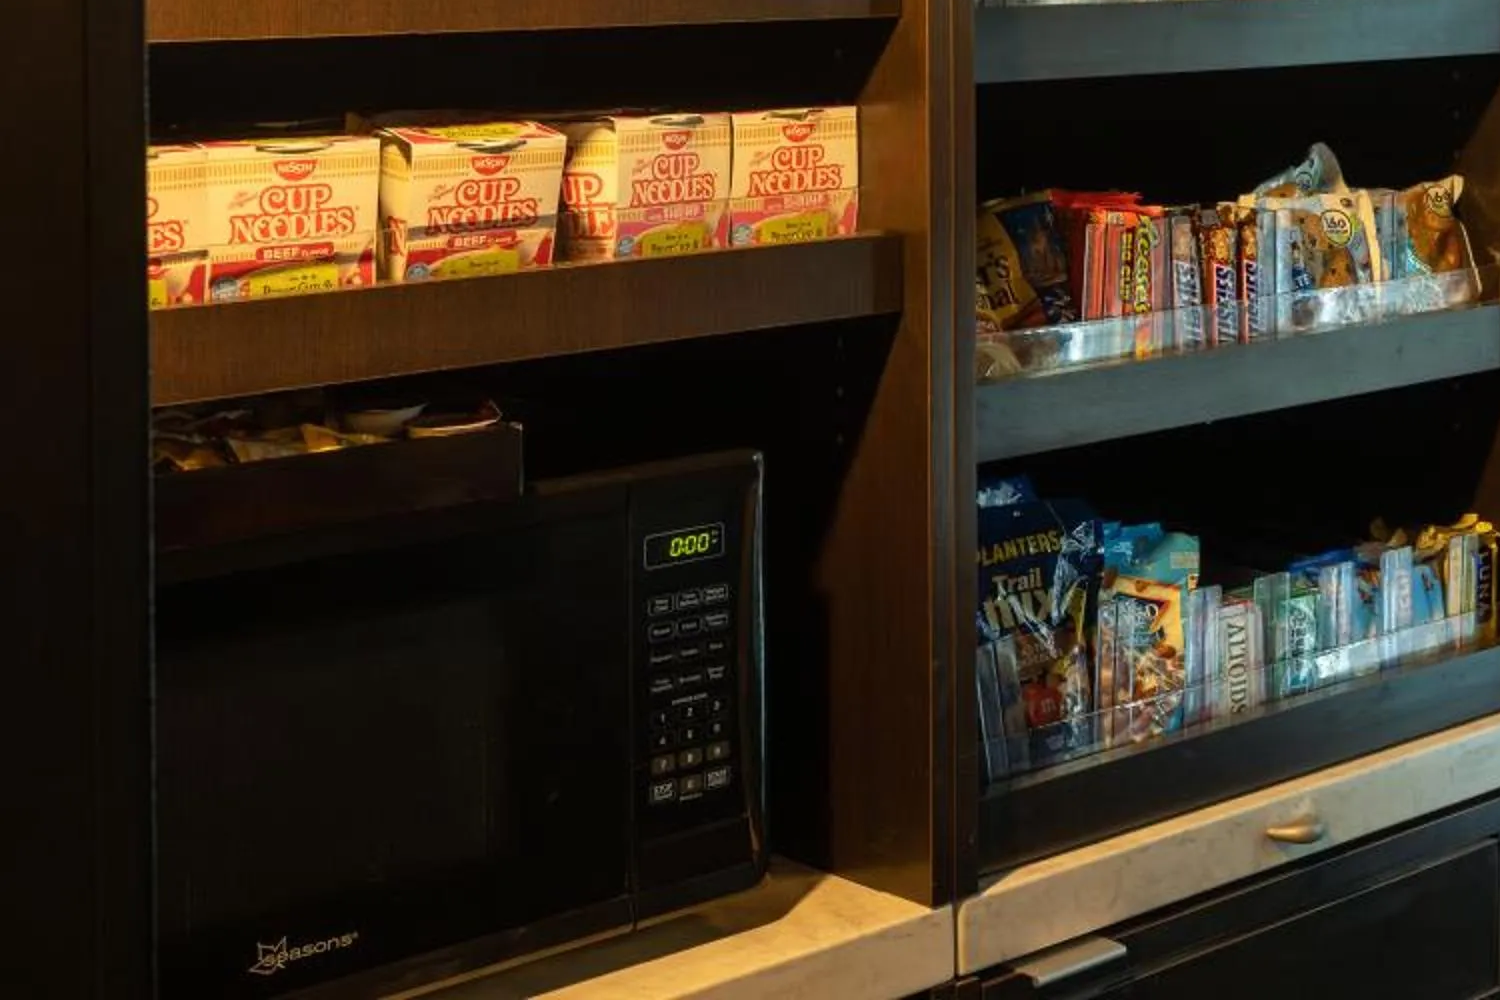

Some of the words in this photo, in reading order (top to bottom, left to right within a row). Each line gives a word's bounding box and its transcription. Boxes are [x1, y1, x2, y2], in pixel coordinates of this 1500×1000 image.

[653, 153, 699, 180] CUP
[772, 145, 824, 171] CUP
[455, 177, 521, 207] CUP
[631, 172, 716, 208] NOODLES
[748, 164, 842, 198] NOODLES
[259, 183, 333, 217] CUP
[427, 197, 539, 236] NOODLES
[229, 205, 356, 245] NOODLES
[669, 533, 711, 557] 0:00
[978, 530, 1060, 567] LANTERS
[1227, 622, 1247, 715] ALTOIDS
